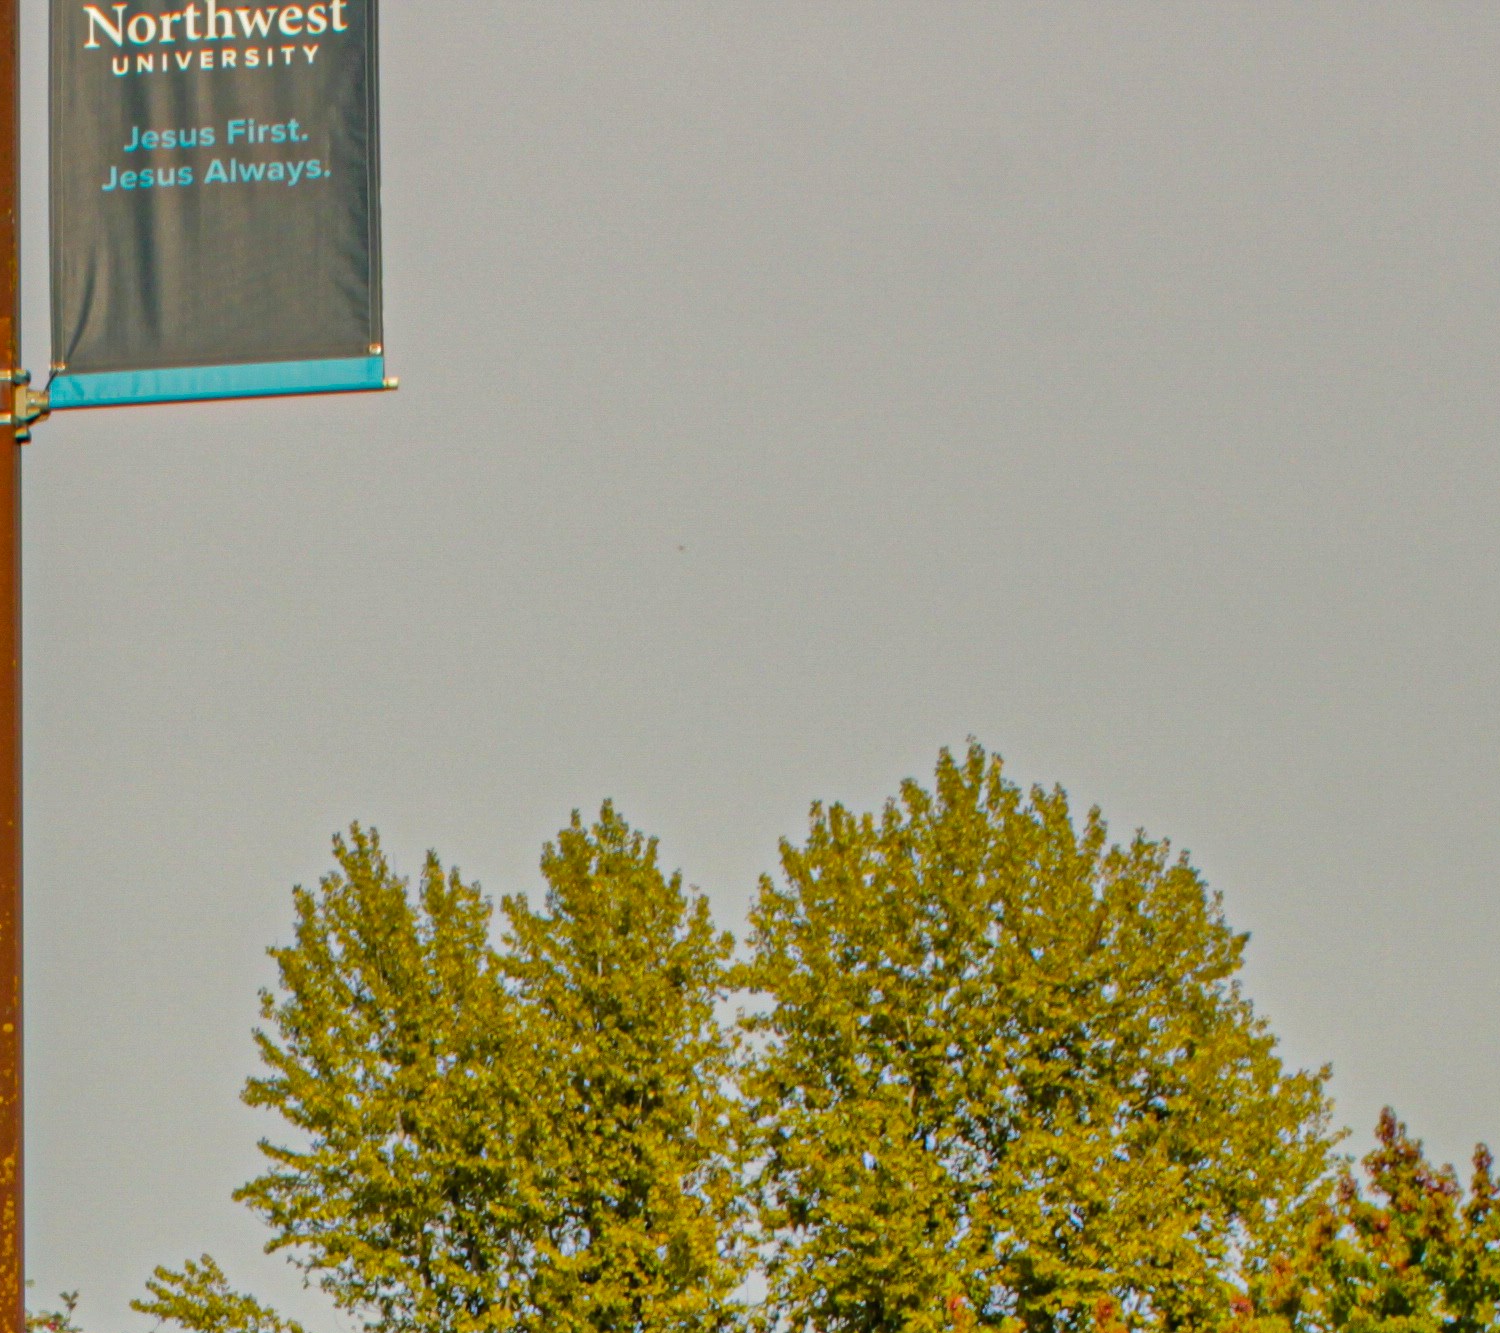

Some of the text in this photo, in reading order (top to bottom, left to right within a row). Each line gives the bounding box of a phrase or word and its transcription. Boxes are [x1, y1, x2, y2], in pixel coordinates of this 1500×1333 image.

[82, 0, 349, 49] Northwest
[111, 43, 319, 77] UNIVERSITY
[123, 117, 310, 153] Jesus First.
[101, 157, 332, 192] Jesus Always.
